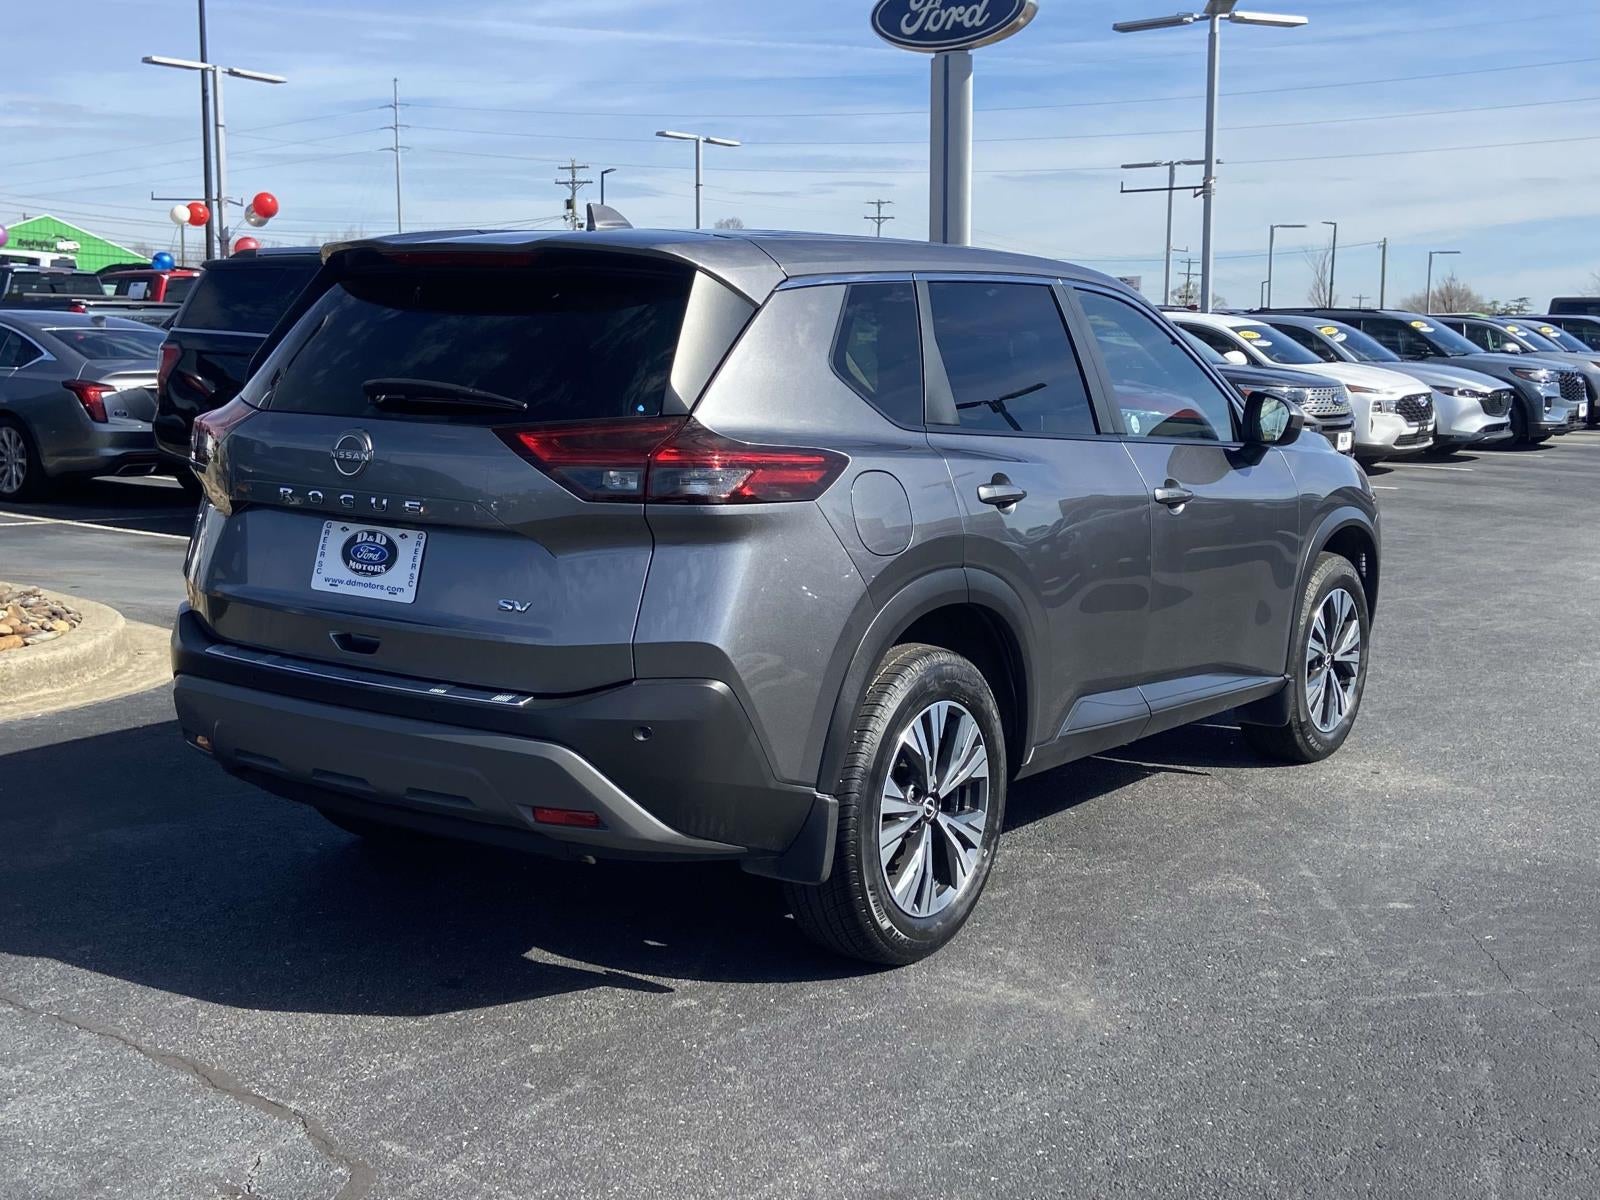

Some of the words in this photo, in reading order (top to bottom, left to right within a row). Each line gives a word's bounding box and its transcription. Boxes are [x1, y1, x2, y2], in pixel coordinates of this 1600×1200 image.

[900, 0, 990, 35] Ford
[330, 450, 370, 461] NISSAN
[279, 486, 424, 514] ROGUE
[320, 522, 333, 558] GREER
[356, 531, 387, 545] D&D
[357, 545, 381, 561] Ford
[411, 533, 424, 570] GREER
[316, 561, 324, 574] SC
[348, 560, 387, 573] MOTORS
[324, 576, 405, 593] www.ddmotors.com
[408, 573, 415, 588] SC
[498, 599, 532, 613] SV
